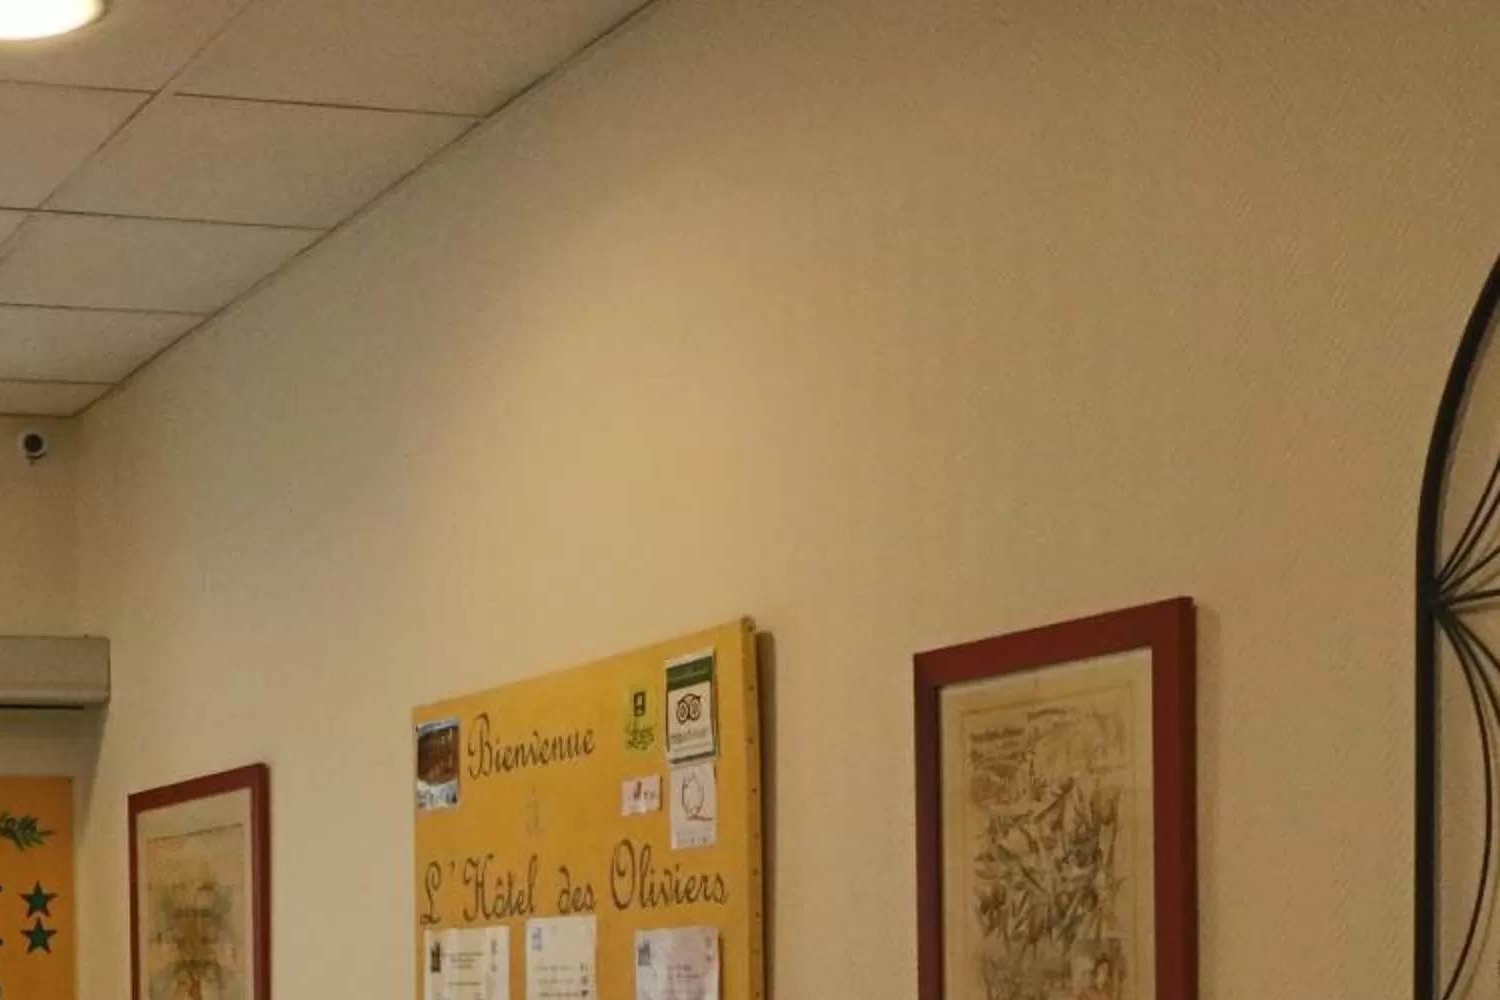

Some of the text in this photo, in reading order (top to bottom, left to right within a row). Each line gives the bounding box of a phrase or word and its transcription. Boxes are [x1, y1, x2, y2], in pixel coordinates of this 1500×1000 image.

[467, 712, 596, 780] Bienvenue
[557, 864, 597, 914] des
[608, 839, 729, 911] Oliviers
